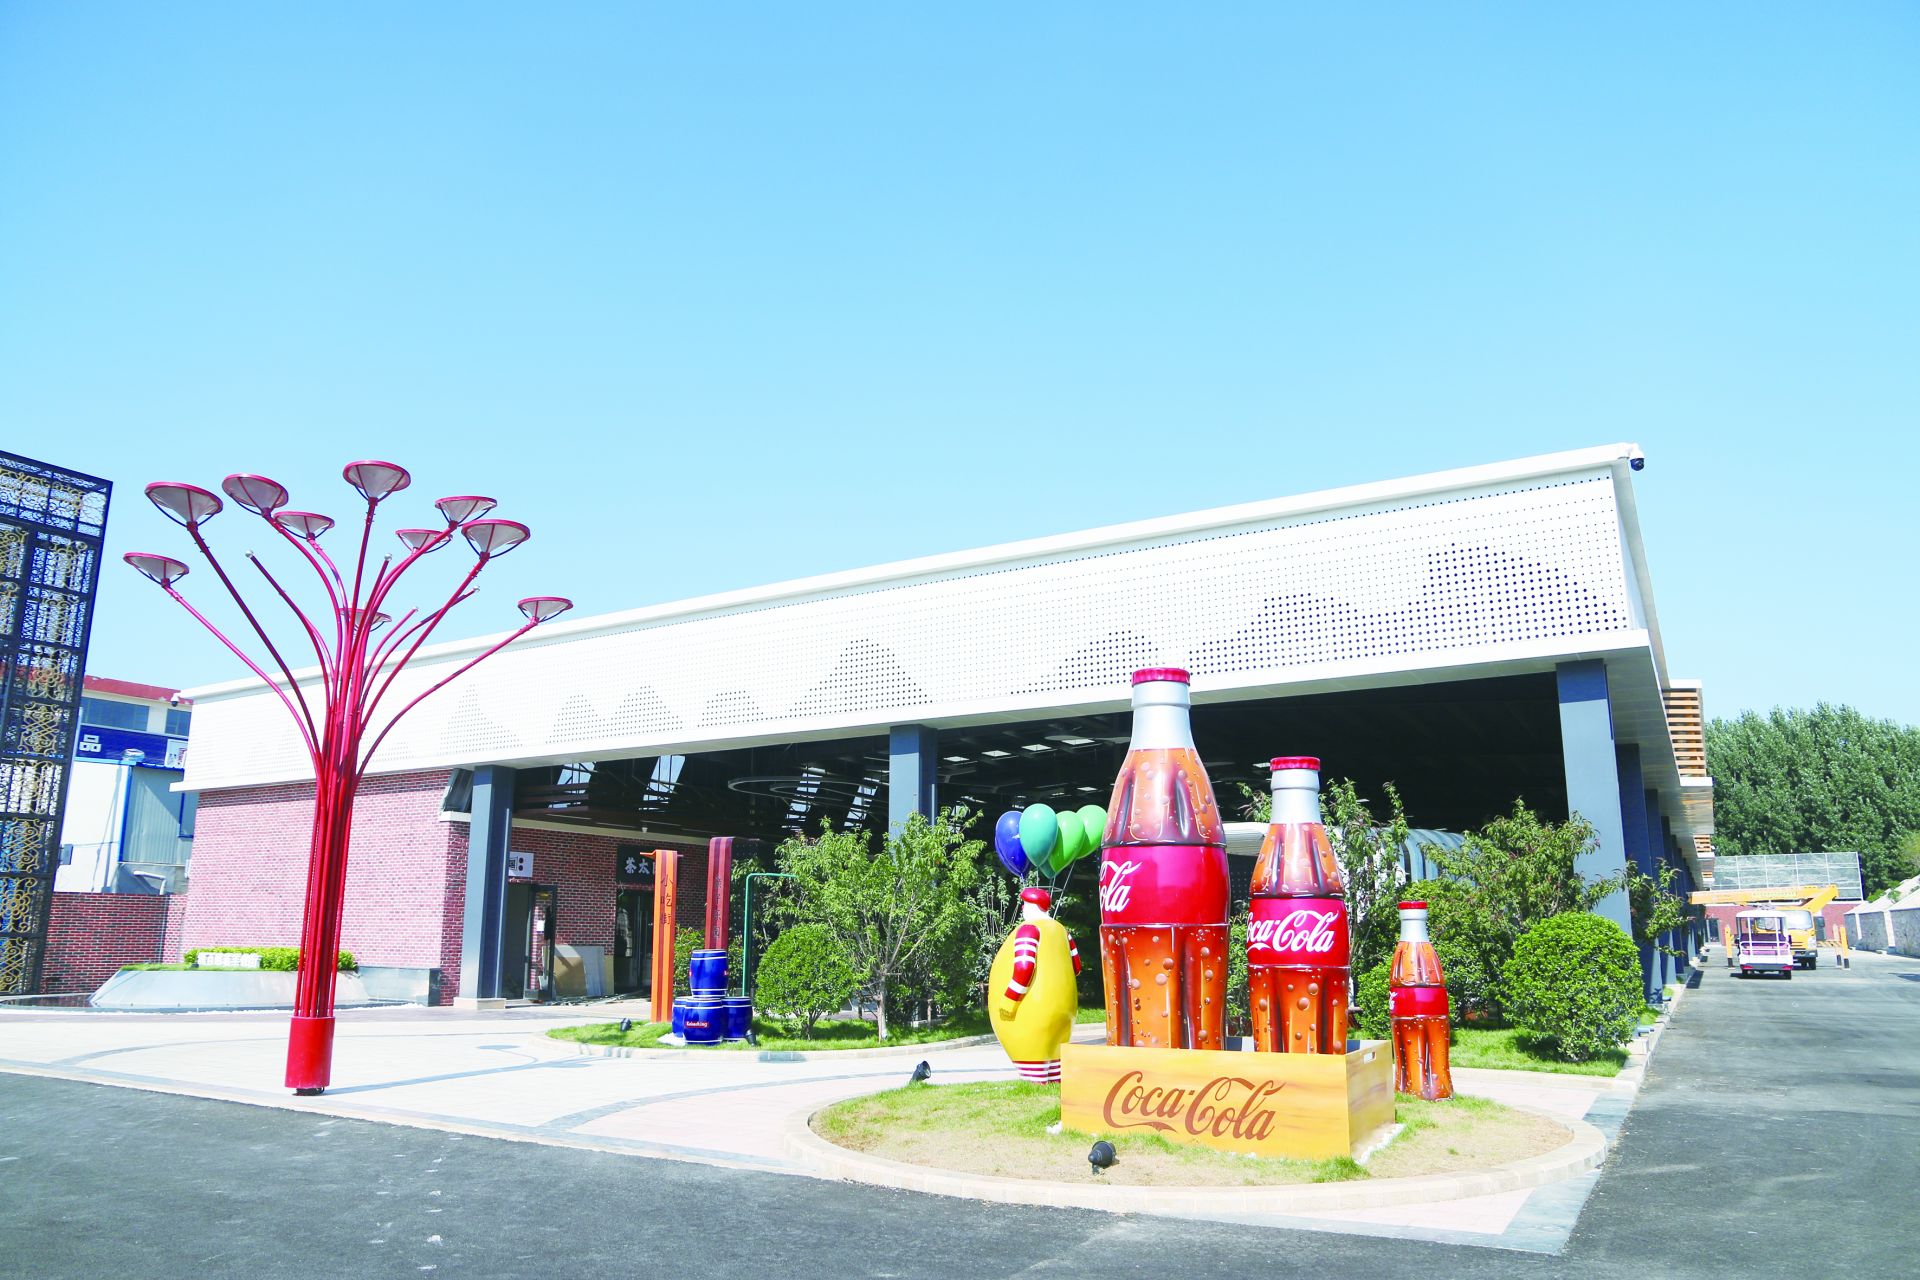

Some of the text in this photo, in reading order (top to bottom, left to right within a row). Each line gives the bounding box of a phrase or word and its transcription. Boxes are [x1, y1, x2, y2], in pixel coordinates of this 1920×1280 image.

[79, 734, 102, 753] 品
[624, 856, 656, 875] 茶太
[661, 873, 674, 926] 小吃街
[1247, 909, 1340, 952] oca-Cola
[1103, 1070, 1287, 1140] Coca-Cola
